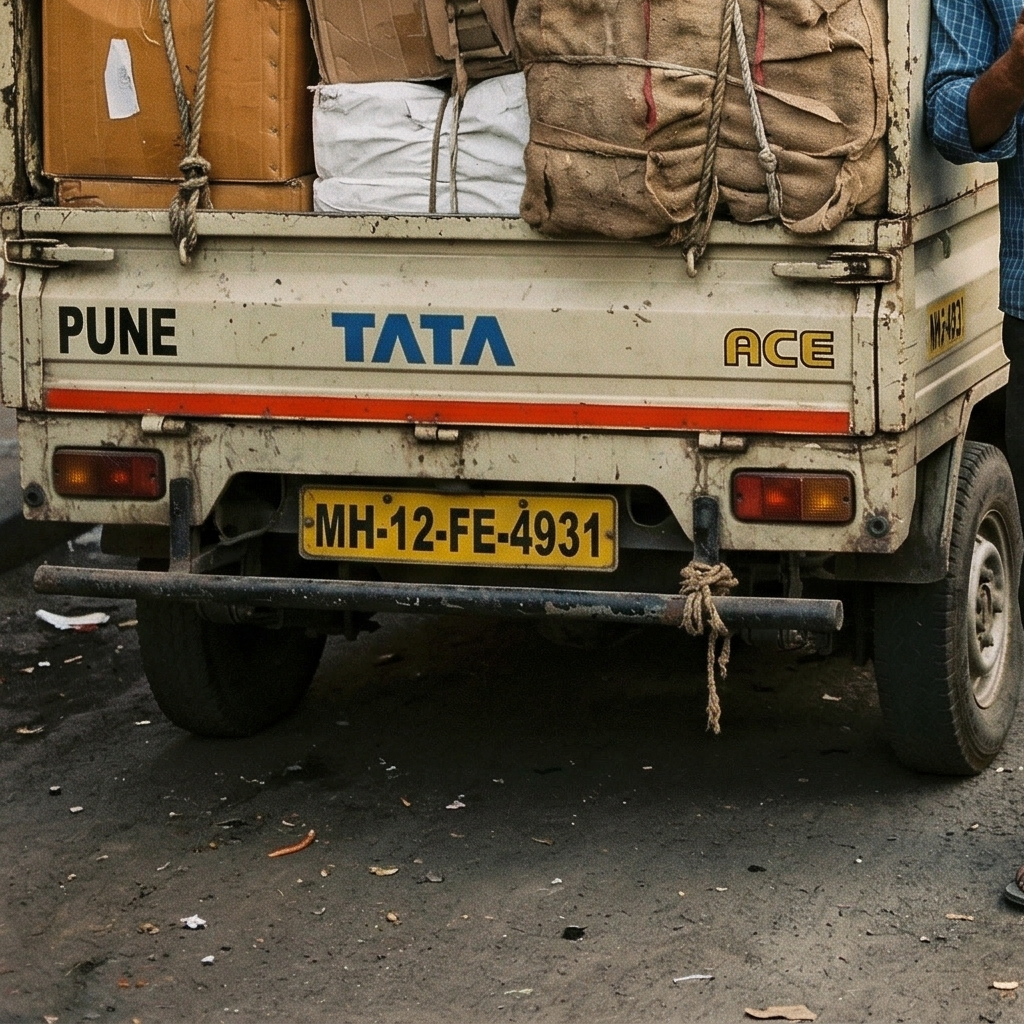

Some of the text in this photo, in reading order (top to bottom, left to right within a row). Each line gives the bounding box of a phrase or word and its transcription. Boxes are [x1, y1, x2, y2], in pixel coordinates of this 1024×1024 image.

[58, 305, 178, 357] PUNE
[331, 312, 515, 367] TATA
[723, 327, 835, 370] ACE
[315, 502, 601, 559] MH-12-FE-4931
